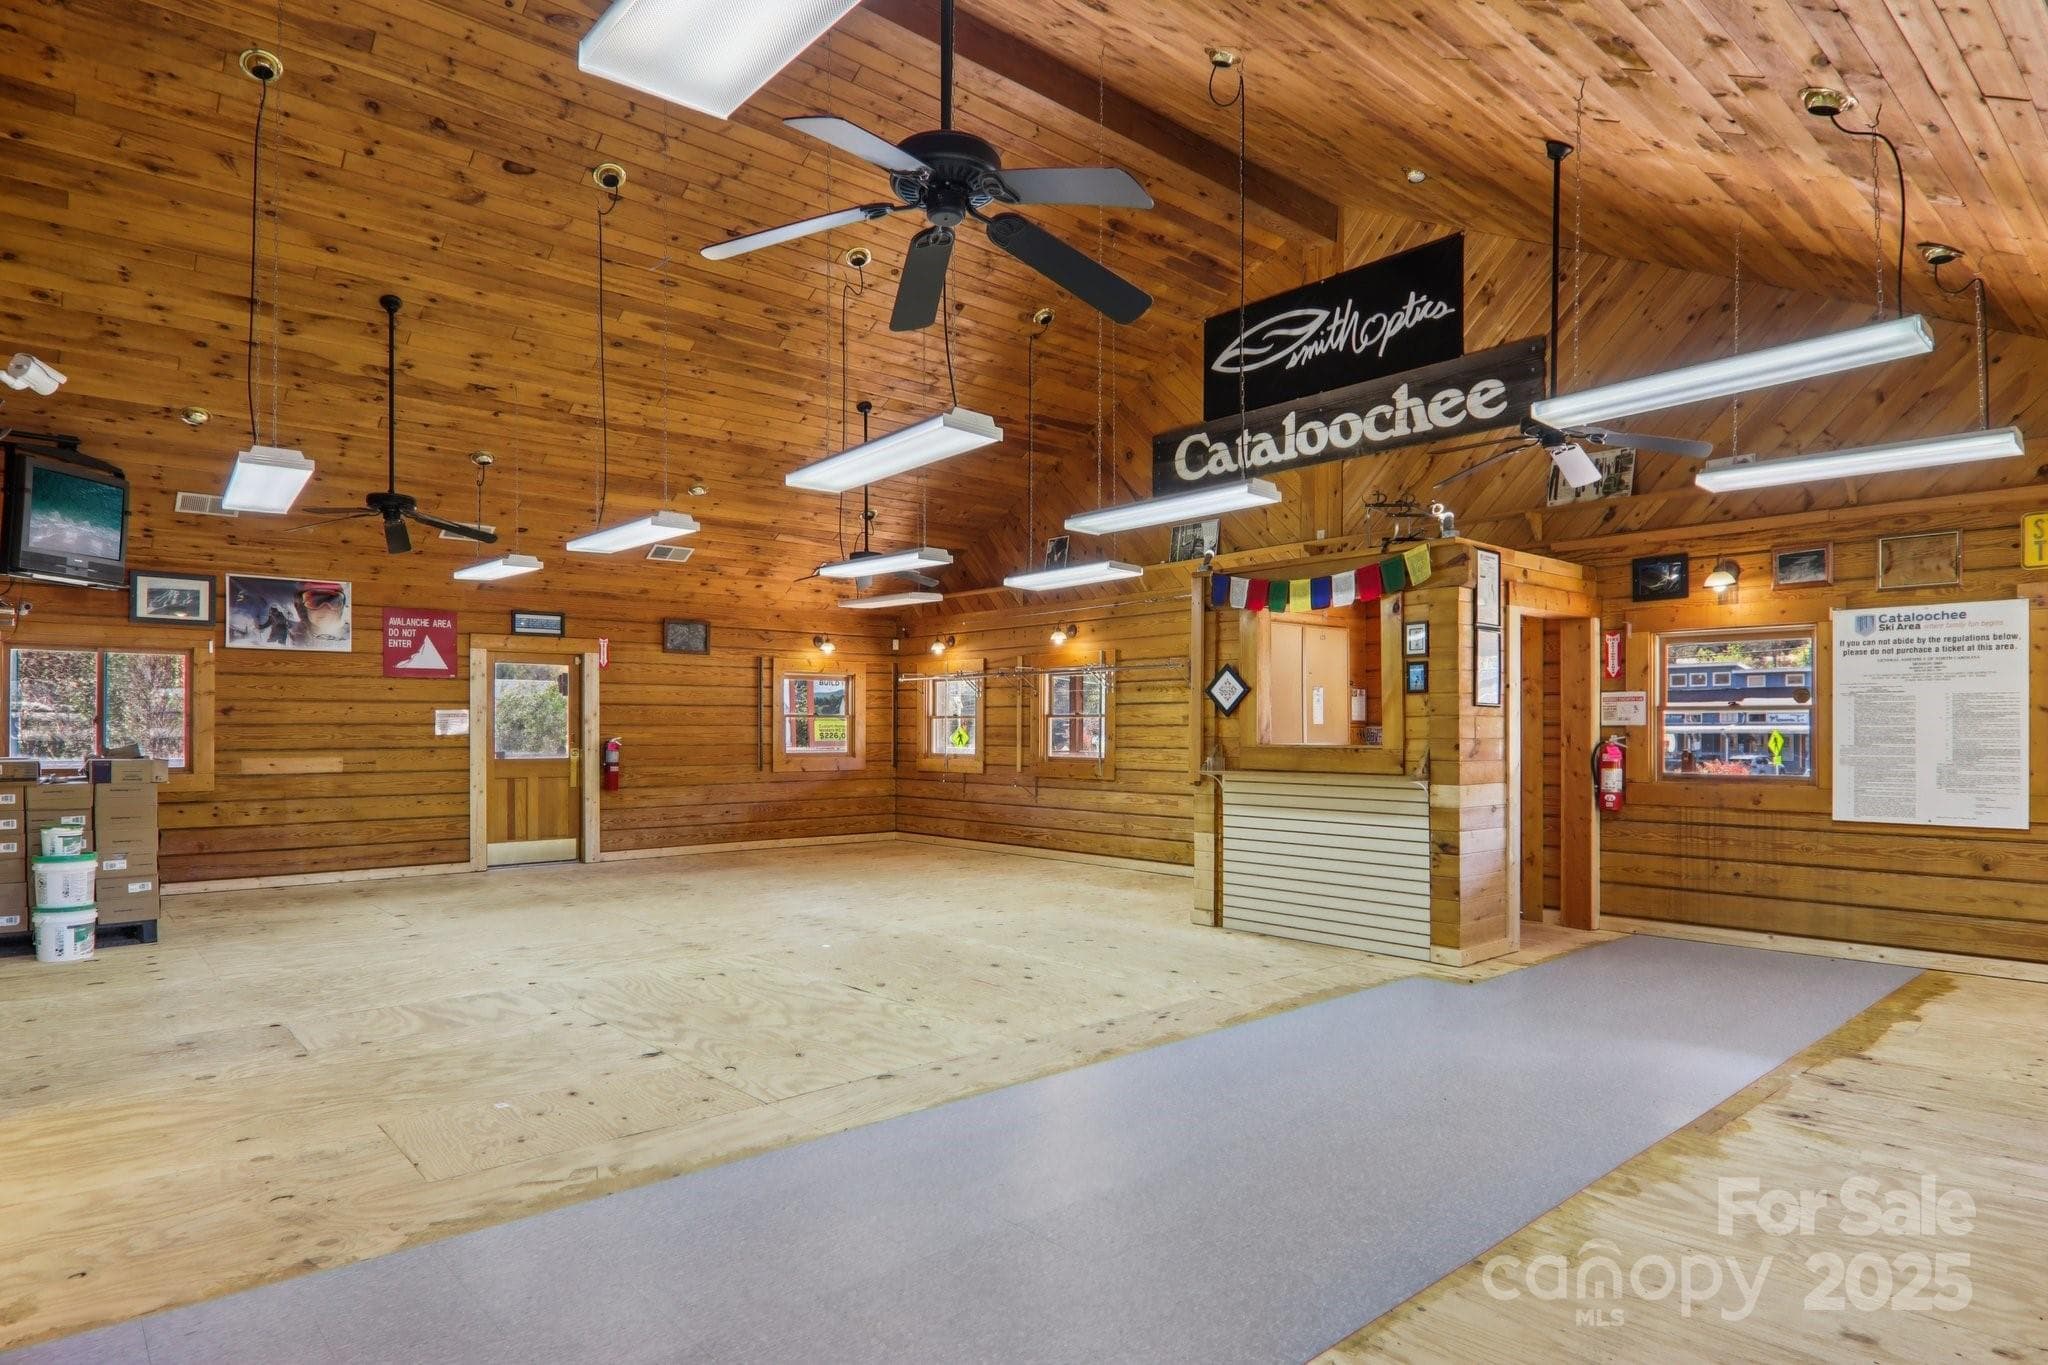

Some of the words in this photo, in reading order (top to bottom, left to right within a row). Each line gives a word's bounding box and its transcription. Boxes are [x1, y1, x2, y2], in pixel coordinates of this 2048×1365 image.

[1174, 378, 1508, 481] Cataloochee
[389, 617, 430, 627] AVALANCHE
[432, 619, 452, 629] AREA
[1878, 611, 1967, 623] Cataloochee
[388, 628, 399, 637] DO
[402, 629, 417, 637] NOT
[1879, 623, 1894, 632] Ski
[388, 639, 412, 648] ENTER
[1846, 640, 1860, 648] you
[1892, 637, 1914, 645] abide
[1917, 636, 1926, 645] by
[1943, 634, 1990, 643] regulations
[1843, 649, 1867, 657] please
[1977, 643, 1993, 651] this
